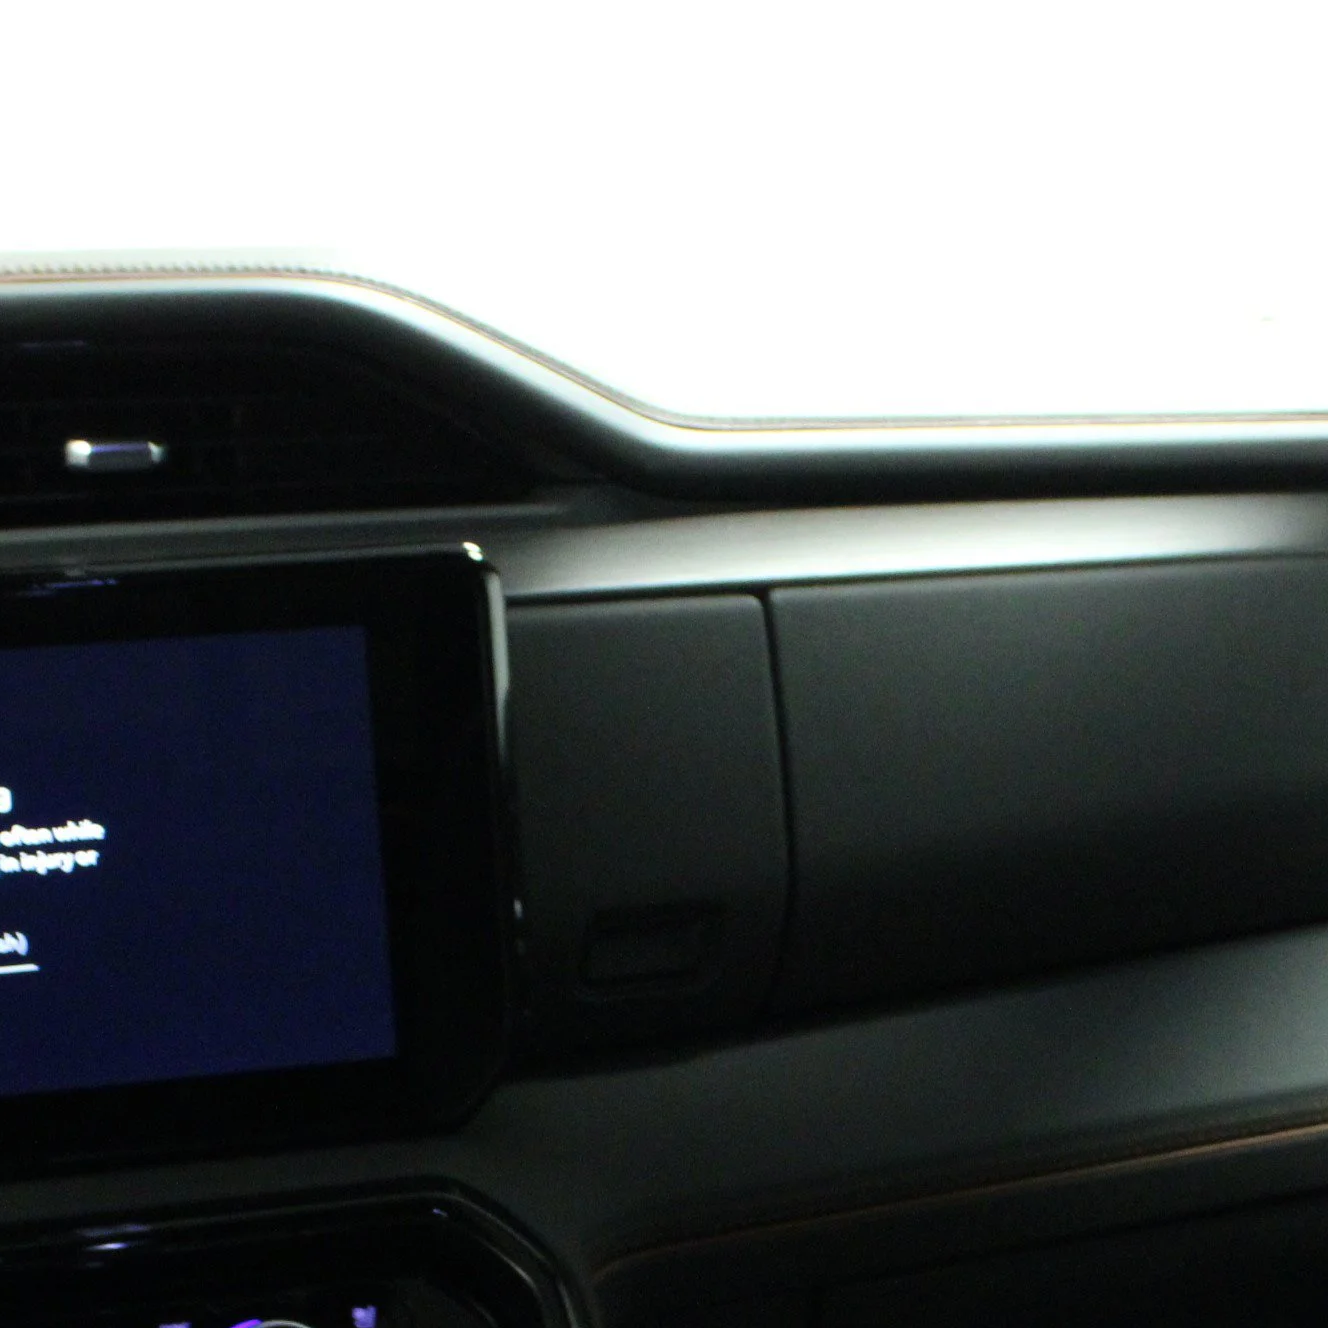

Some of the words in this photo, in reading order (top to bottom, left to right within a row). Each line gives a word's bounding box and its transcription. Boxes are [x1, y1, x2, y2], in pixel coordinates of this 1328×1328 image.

[52, 819, 105, 842] while
[20, 850, 74, 875] injury
[74, 849, 99, 867] or
